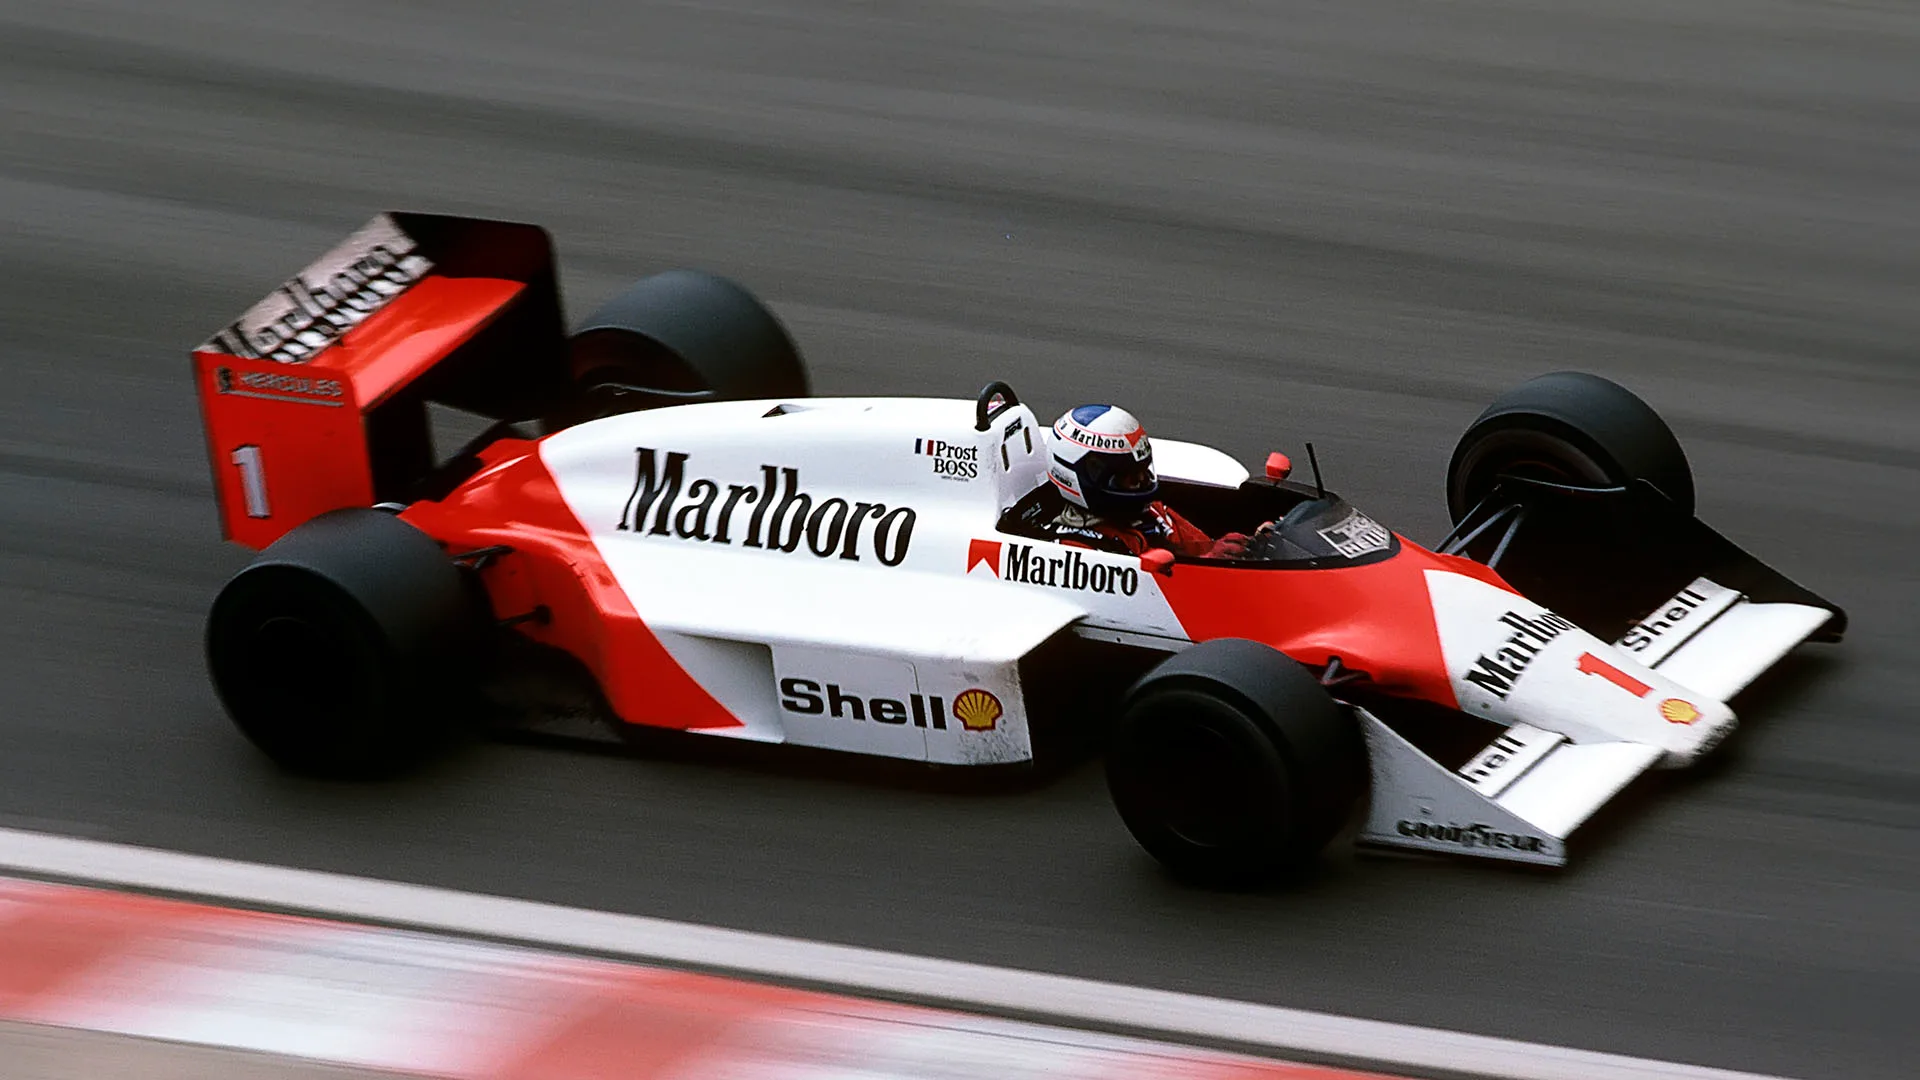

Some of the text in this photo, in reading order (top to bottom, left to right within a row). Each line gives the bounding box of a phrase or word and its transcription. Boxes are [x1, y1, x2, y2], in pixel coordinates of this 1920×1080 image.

[935, 440, 978, 461] Prost
[1072, 428, 1125, 449] Marlboro
[231, 445, 270, 518] 1
[933, 457, 978, 479] BOSS
[616, 447, 917, 567] Marlboro
[1004, 543, 1138, 596] Marlboro
[1621, 588, 1708, 652] Shell
[1463, 610, 1578, 700] Marlbor
[1576, 651, 1655, 698] 1
[780, 678, 947, 730] Shell
[1455, 733, 1528, 785] hell
